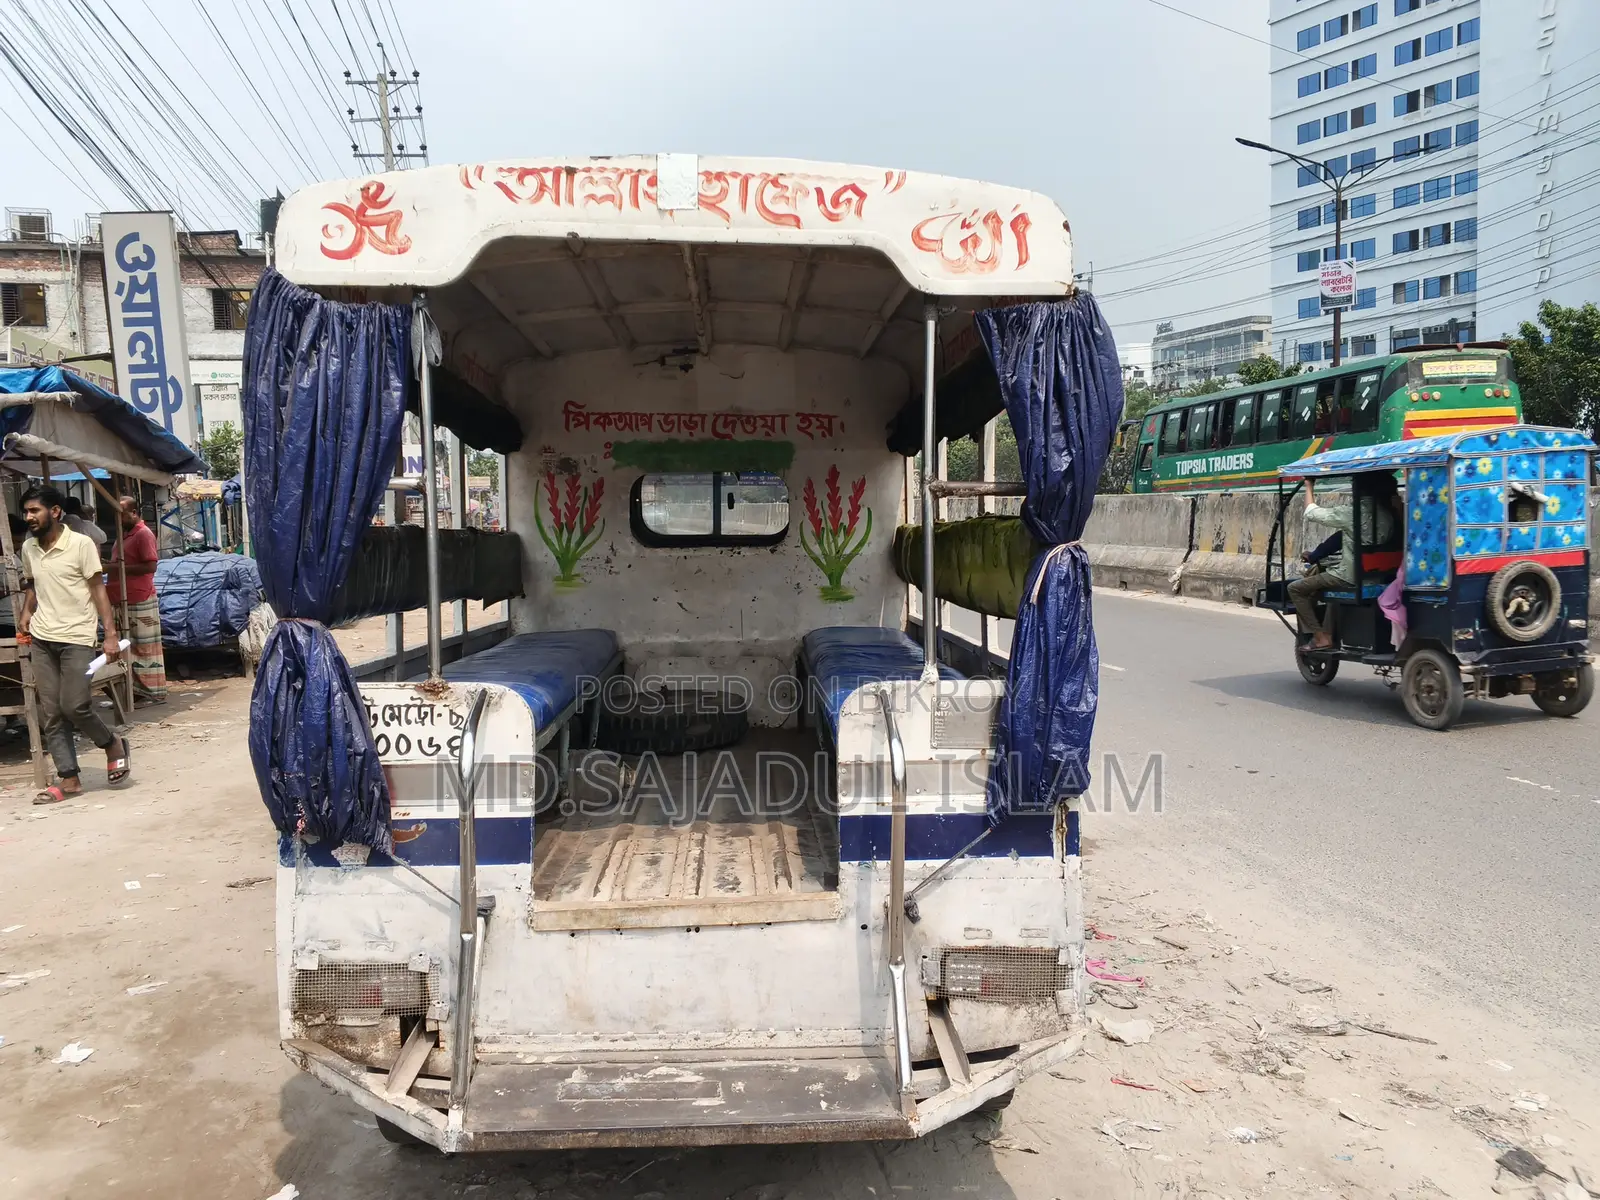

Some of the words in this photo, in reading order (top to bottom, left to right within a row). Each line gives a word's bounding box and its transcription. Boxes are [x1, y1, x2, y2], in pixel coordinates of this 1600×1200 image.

[115, 231, 183, 434] ওয়ালট
[1176, 459, 1207, 476] TOPSIA
[1208, 453, 1254, 472] TRADERS
